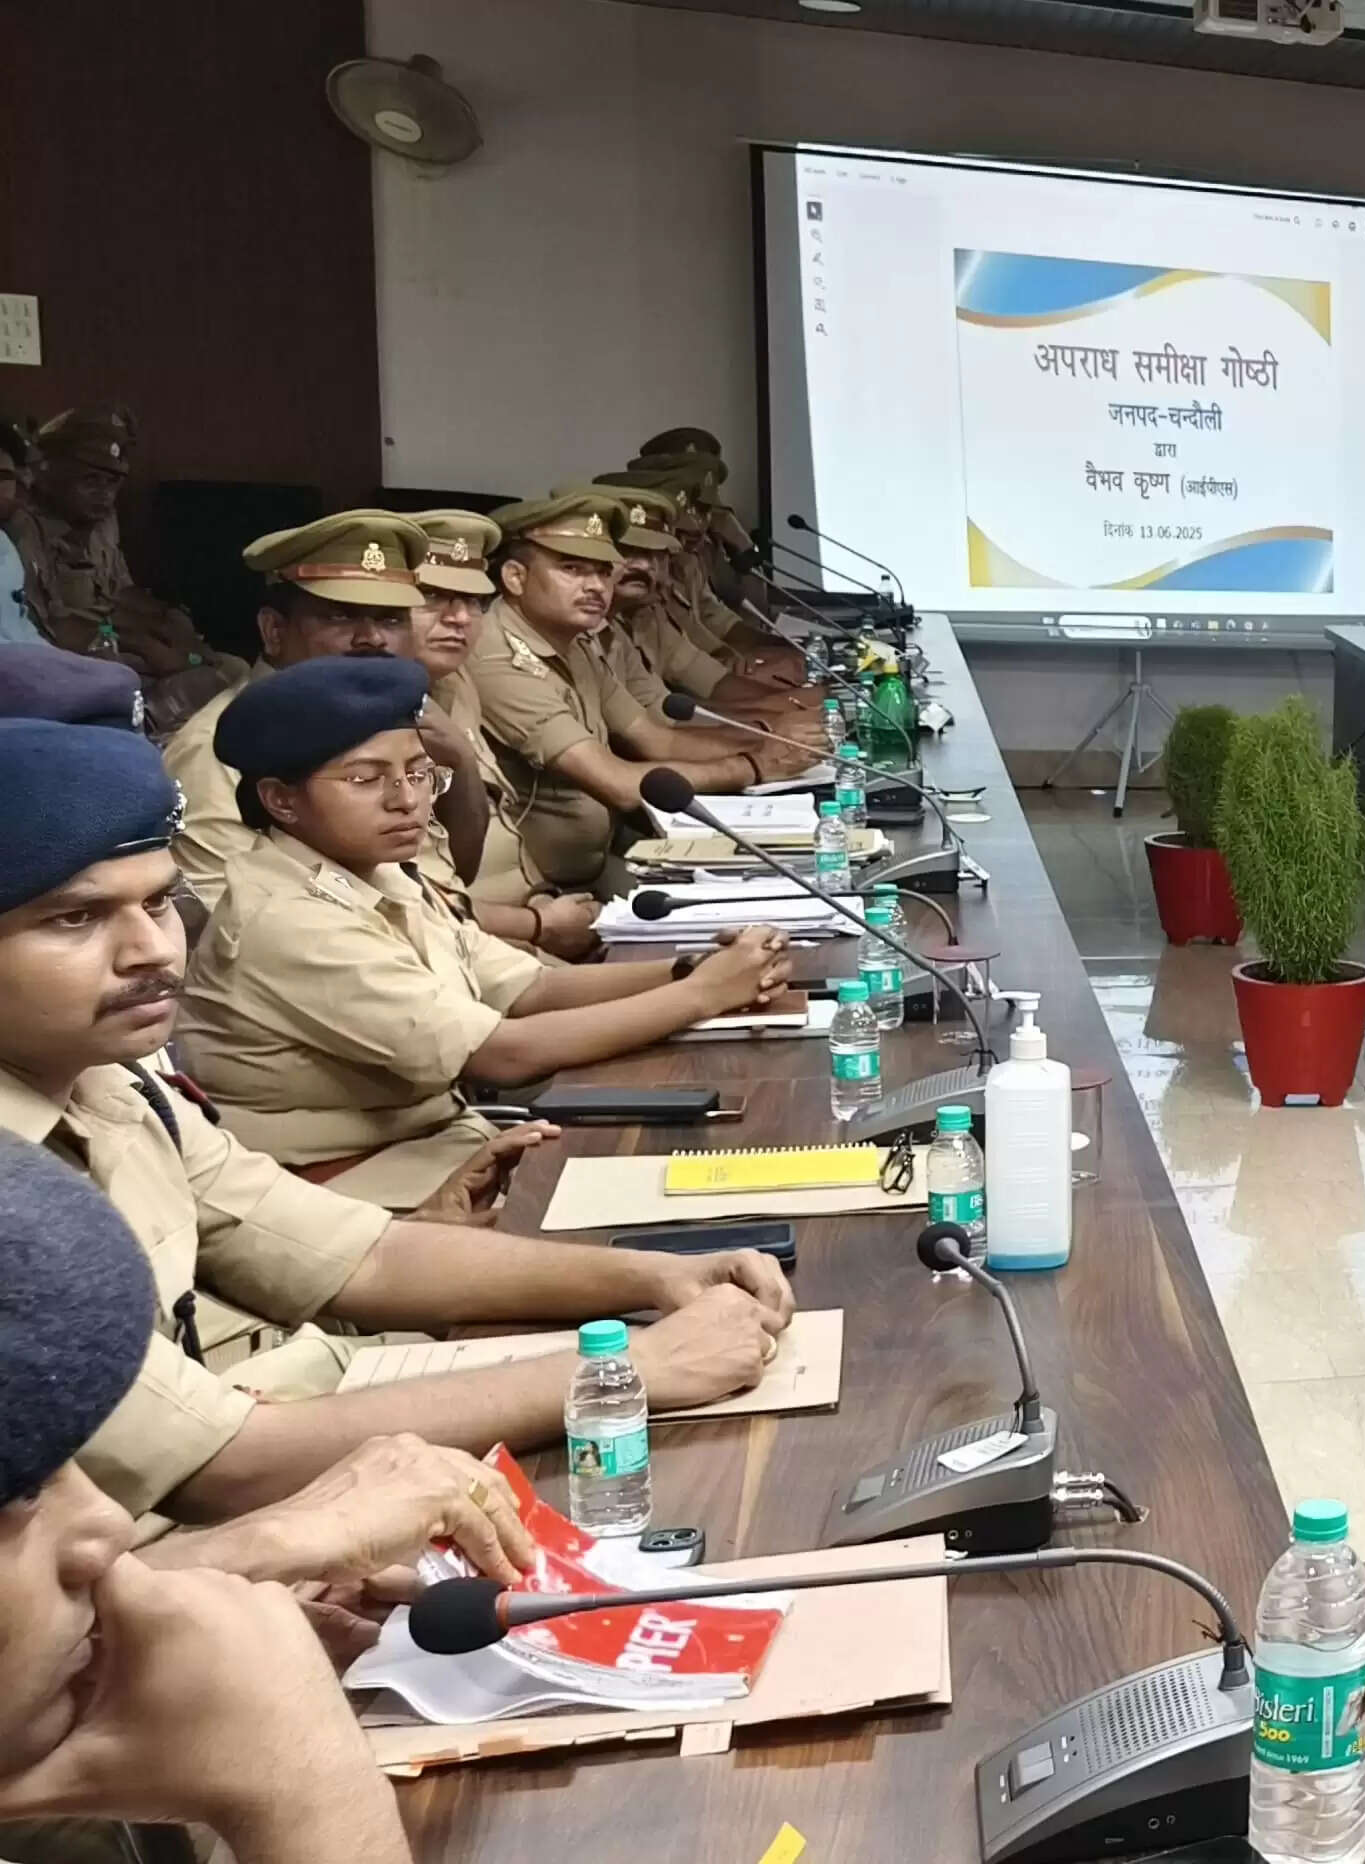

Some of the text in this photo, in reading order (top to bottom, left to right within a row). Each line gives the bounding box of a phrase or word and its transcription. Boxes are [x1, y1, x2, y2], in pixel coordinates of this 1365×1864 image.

[1033, 341, 1279, 390] अपराध समीक्षा गोष्ठी
[1152, 442, 1177, 458] द्वारा
[1085, 461, 1125, 492] वैभव
[1132, 470, 1171, 500] कृष्ण
[1139, 525, 1203, 541] 13.06.2025
[1259, 1720, 1291, 1742] 500
